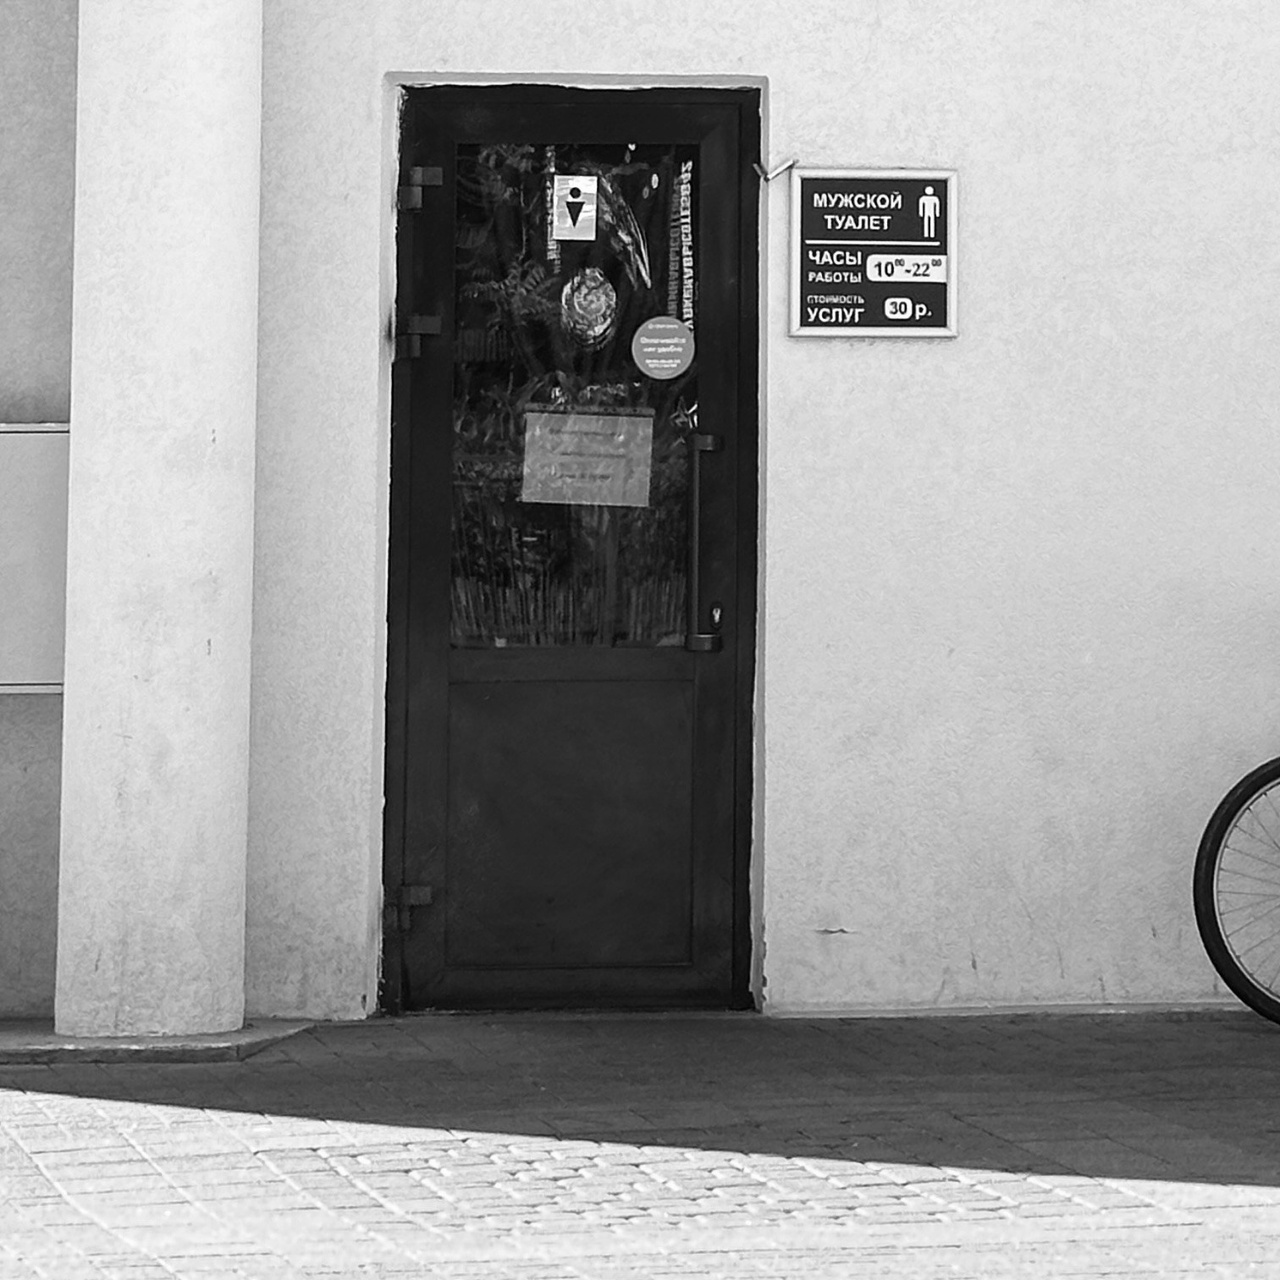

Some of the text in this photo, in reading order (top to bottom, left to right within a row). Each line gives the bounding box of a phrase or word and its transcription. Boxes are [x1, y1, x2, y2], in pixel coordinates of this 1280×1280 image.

[813, 191, 902, 209] МУЖСКОЙ
[824, 215, 892, 230] ТУАЛЕТ
[808, 250, 862, 265] ЧАСЫ
[808, 272, 862, 283] РАБОТЫ
[807, 308, 865, 323] УСЛУГ
